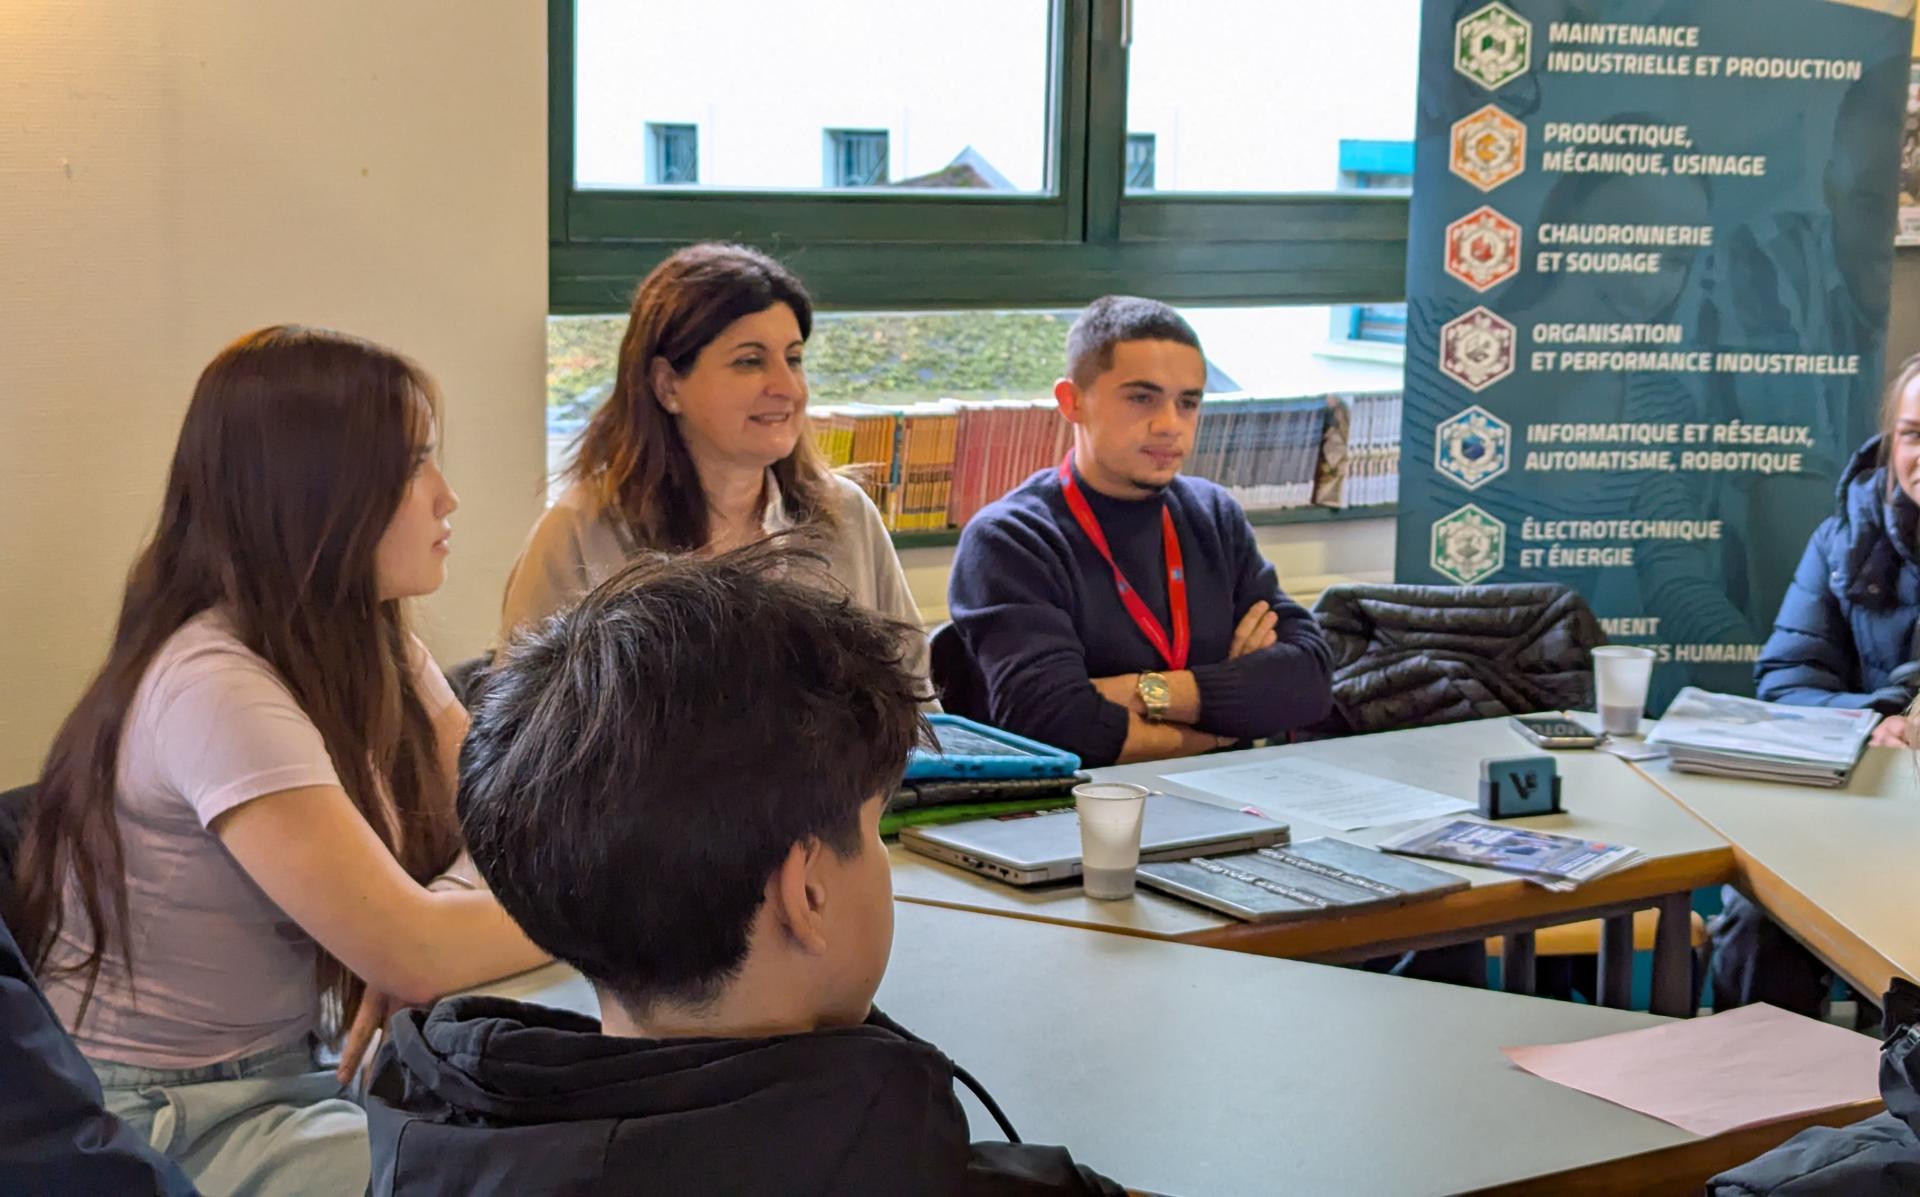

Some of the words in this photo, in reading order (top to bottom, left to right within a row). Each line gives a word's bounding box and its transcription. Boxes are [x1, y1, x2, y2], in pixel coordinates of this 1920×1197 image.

[1548, 22, 1699, 47] MAINTENANCE
[1547, 53, 1690, 76] INDUSTRIELLE
[1694, 56, 1721, 77] ET
[1725, 57, 1862, 80] PRODUCTION
[1544, 123, 1693, 147] PRODUCTIQUE,
[1542, 147, 1669, 176] MÉCANIQUE,
[1672, 155, 1766, 177] USINAGE
[1538, 223, 1713, 246] CHAUDRONNERIE
[1536, 252, 1561, 272] ET
[1566, 253, 1660, 273] SOUDAGE
[1532, 323, 1682, 344] ORGANISATION
[1531, 352, 1556, 371] ET
[1560, 352, 1712, 373] PERFORMANCE
[1715, 353, 1860, 375] INDUSTRIELLE
[1527, 424, 1679, 446] INFORMATIQUE
[1683, 425, 1708, 444] ET
[1713, 420, 1815, 448] RÉSEAUX,
[1525, 451, 1676, 473] AUTOMATISME,
[1681, 452, 1803, 474] ROBOTIQUE
[1521, 517, 1722, 541] ÉLECTROTECHNIQUE
[1520, 548, 1544, 568] ET
[1548, 545, 1634, 568] ÉNERGIE
